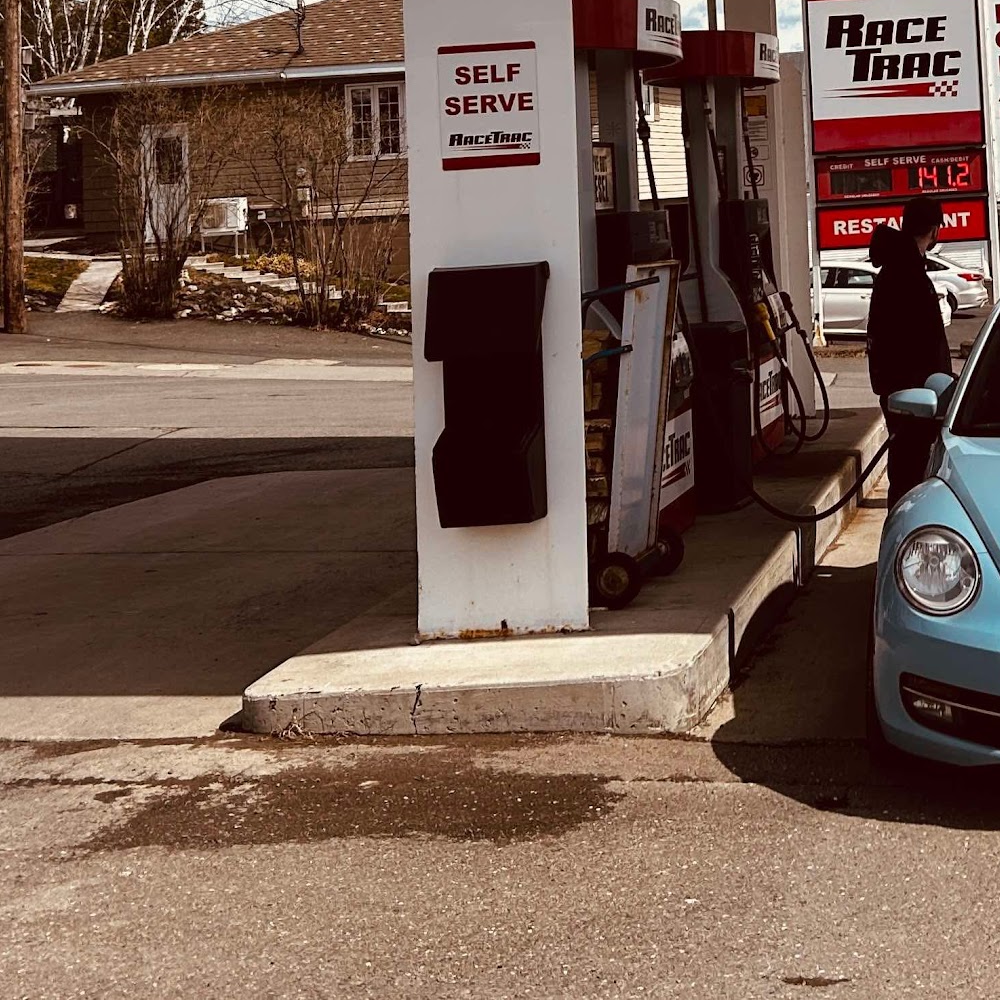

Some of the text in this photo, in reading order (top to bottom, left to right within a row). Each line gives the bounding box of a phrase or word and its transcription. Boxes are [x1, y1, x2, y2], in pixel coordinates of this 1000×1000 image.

[825, 13, 947, 49] RACE
[455, 63, 521, 85] SELF
[845, 47, 962, 83] TRAC
[444, 92, 534, 116] SERVE
[864, 155, 927, 167] SELF SERVE
